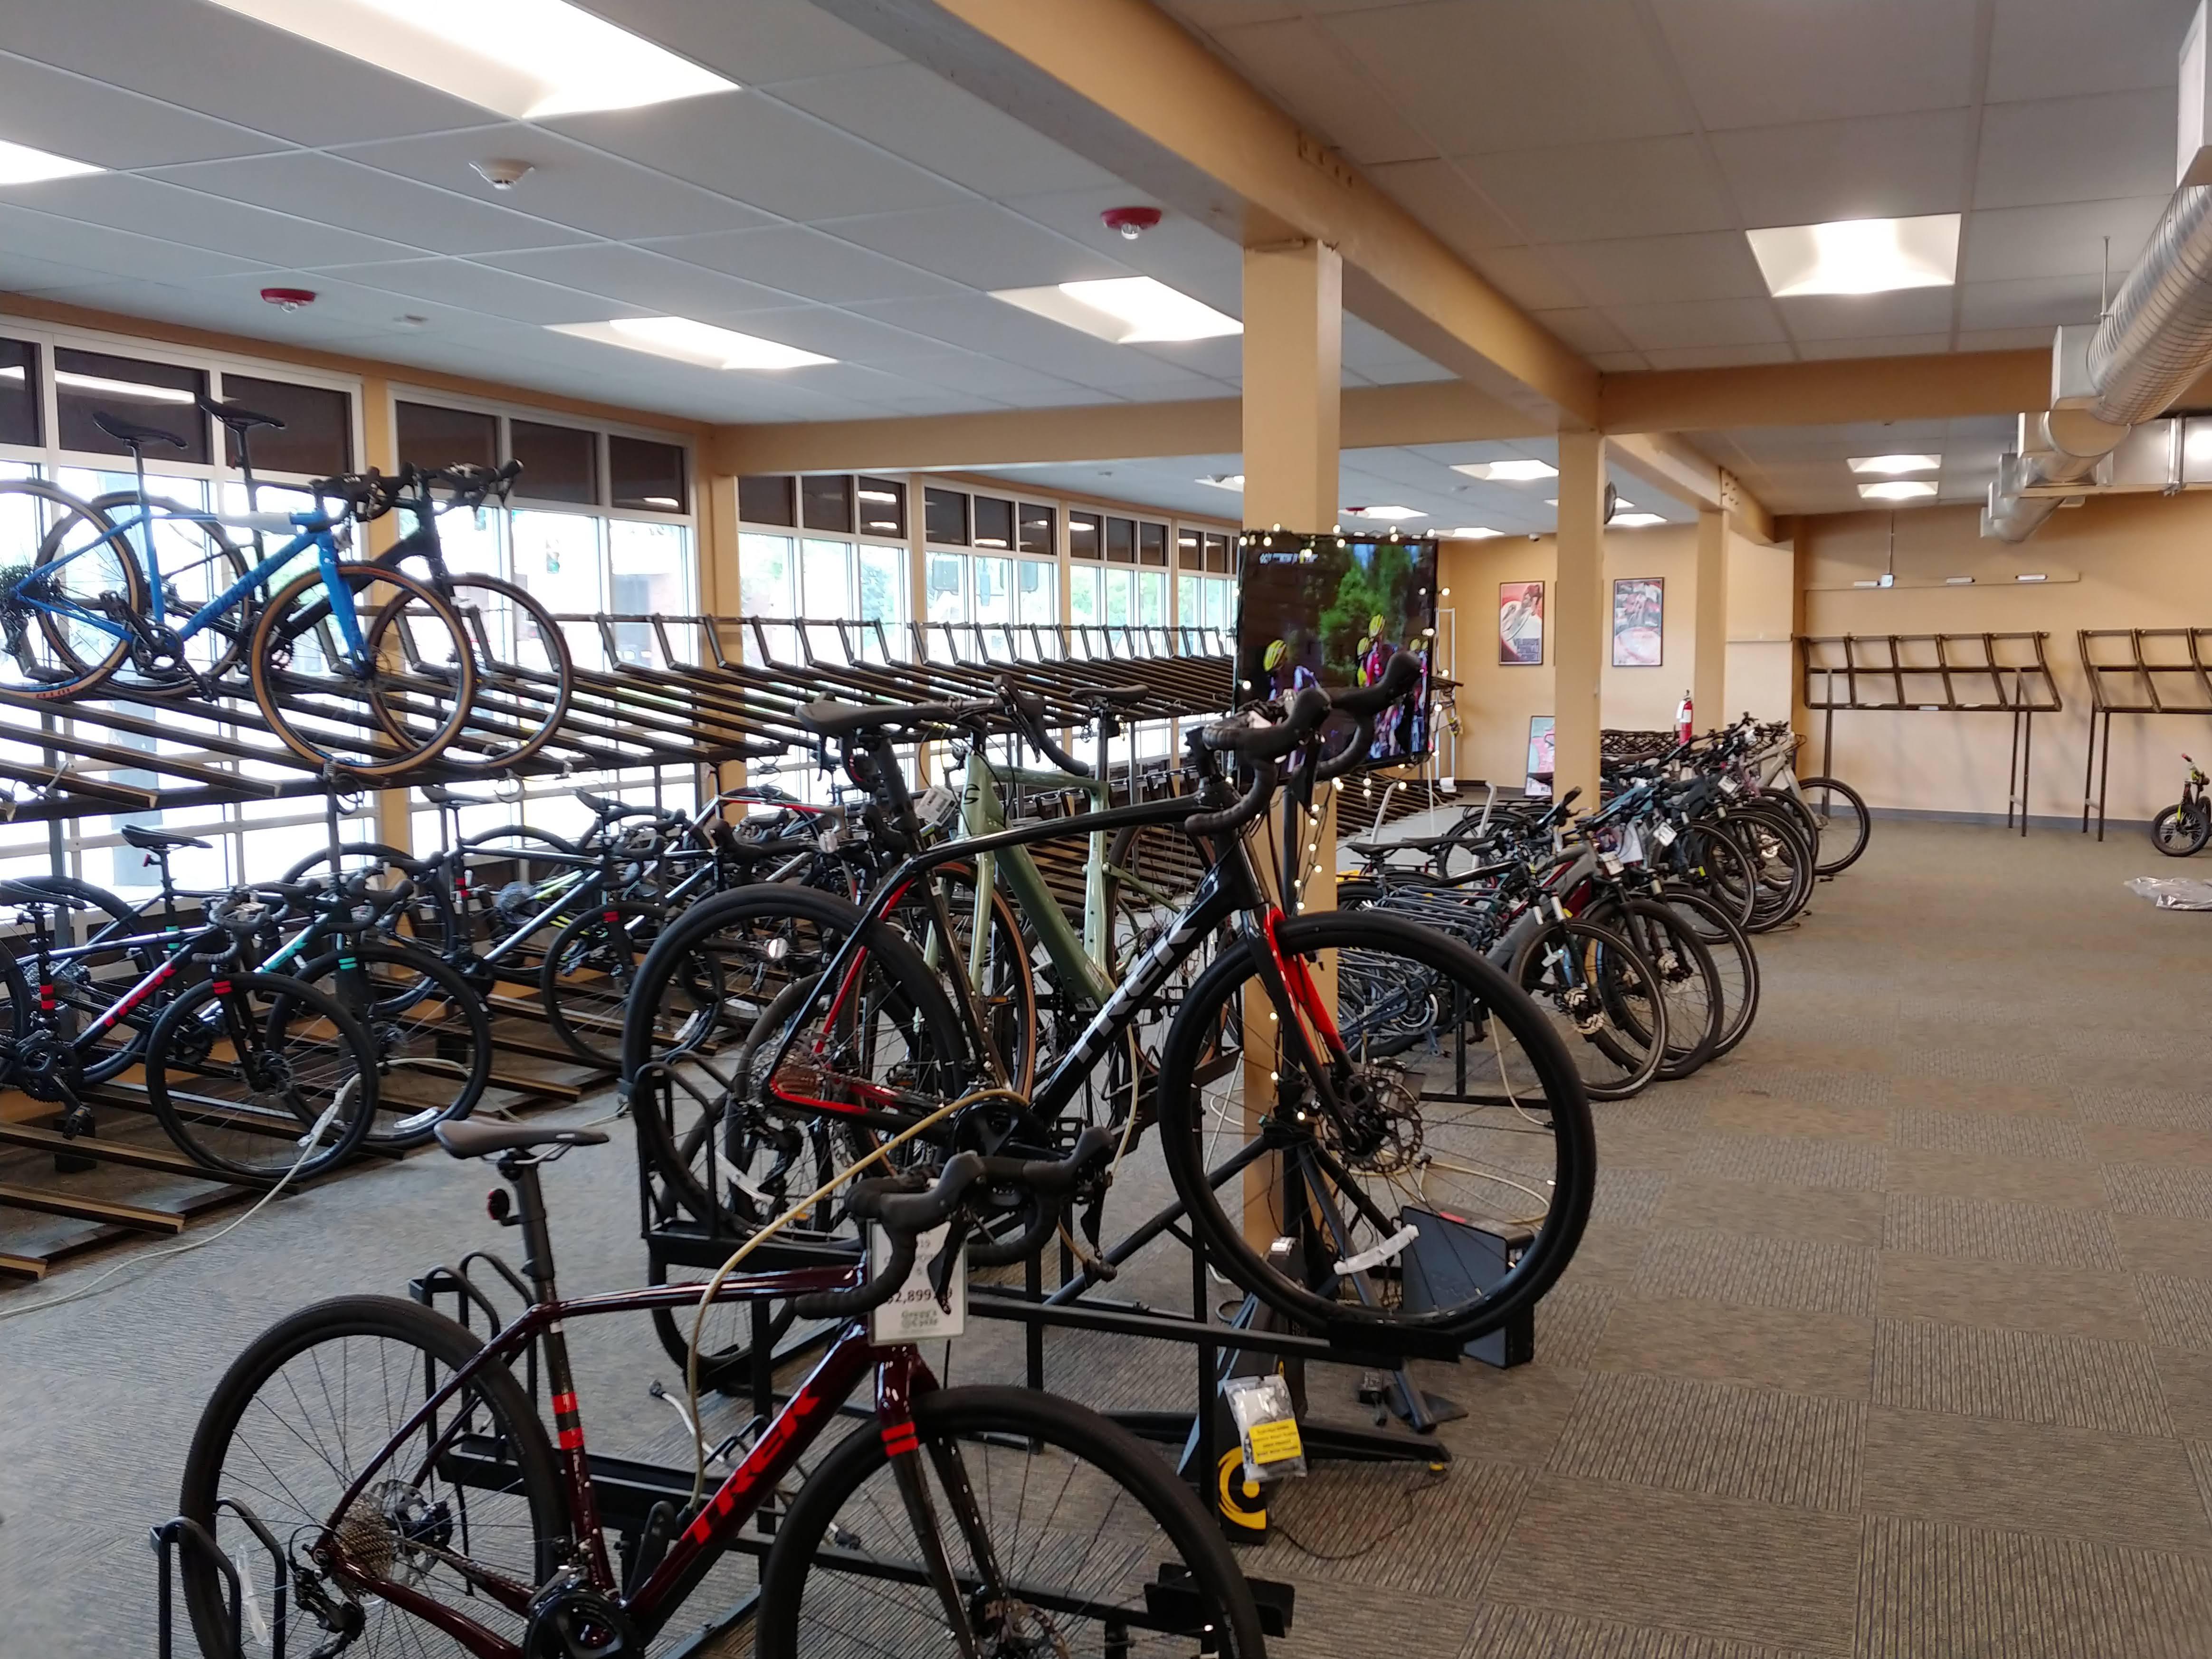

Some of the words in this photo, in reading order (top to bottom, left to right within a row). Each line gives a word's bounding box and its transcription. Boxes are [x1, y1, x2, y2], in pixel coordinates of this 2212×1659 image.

[104, 962, 176, 1027] TREK
[1064, 910, 1197, 1065] TREK
[681, 1386, 820, 1545] TREK
